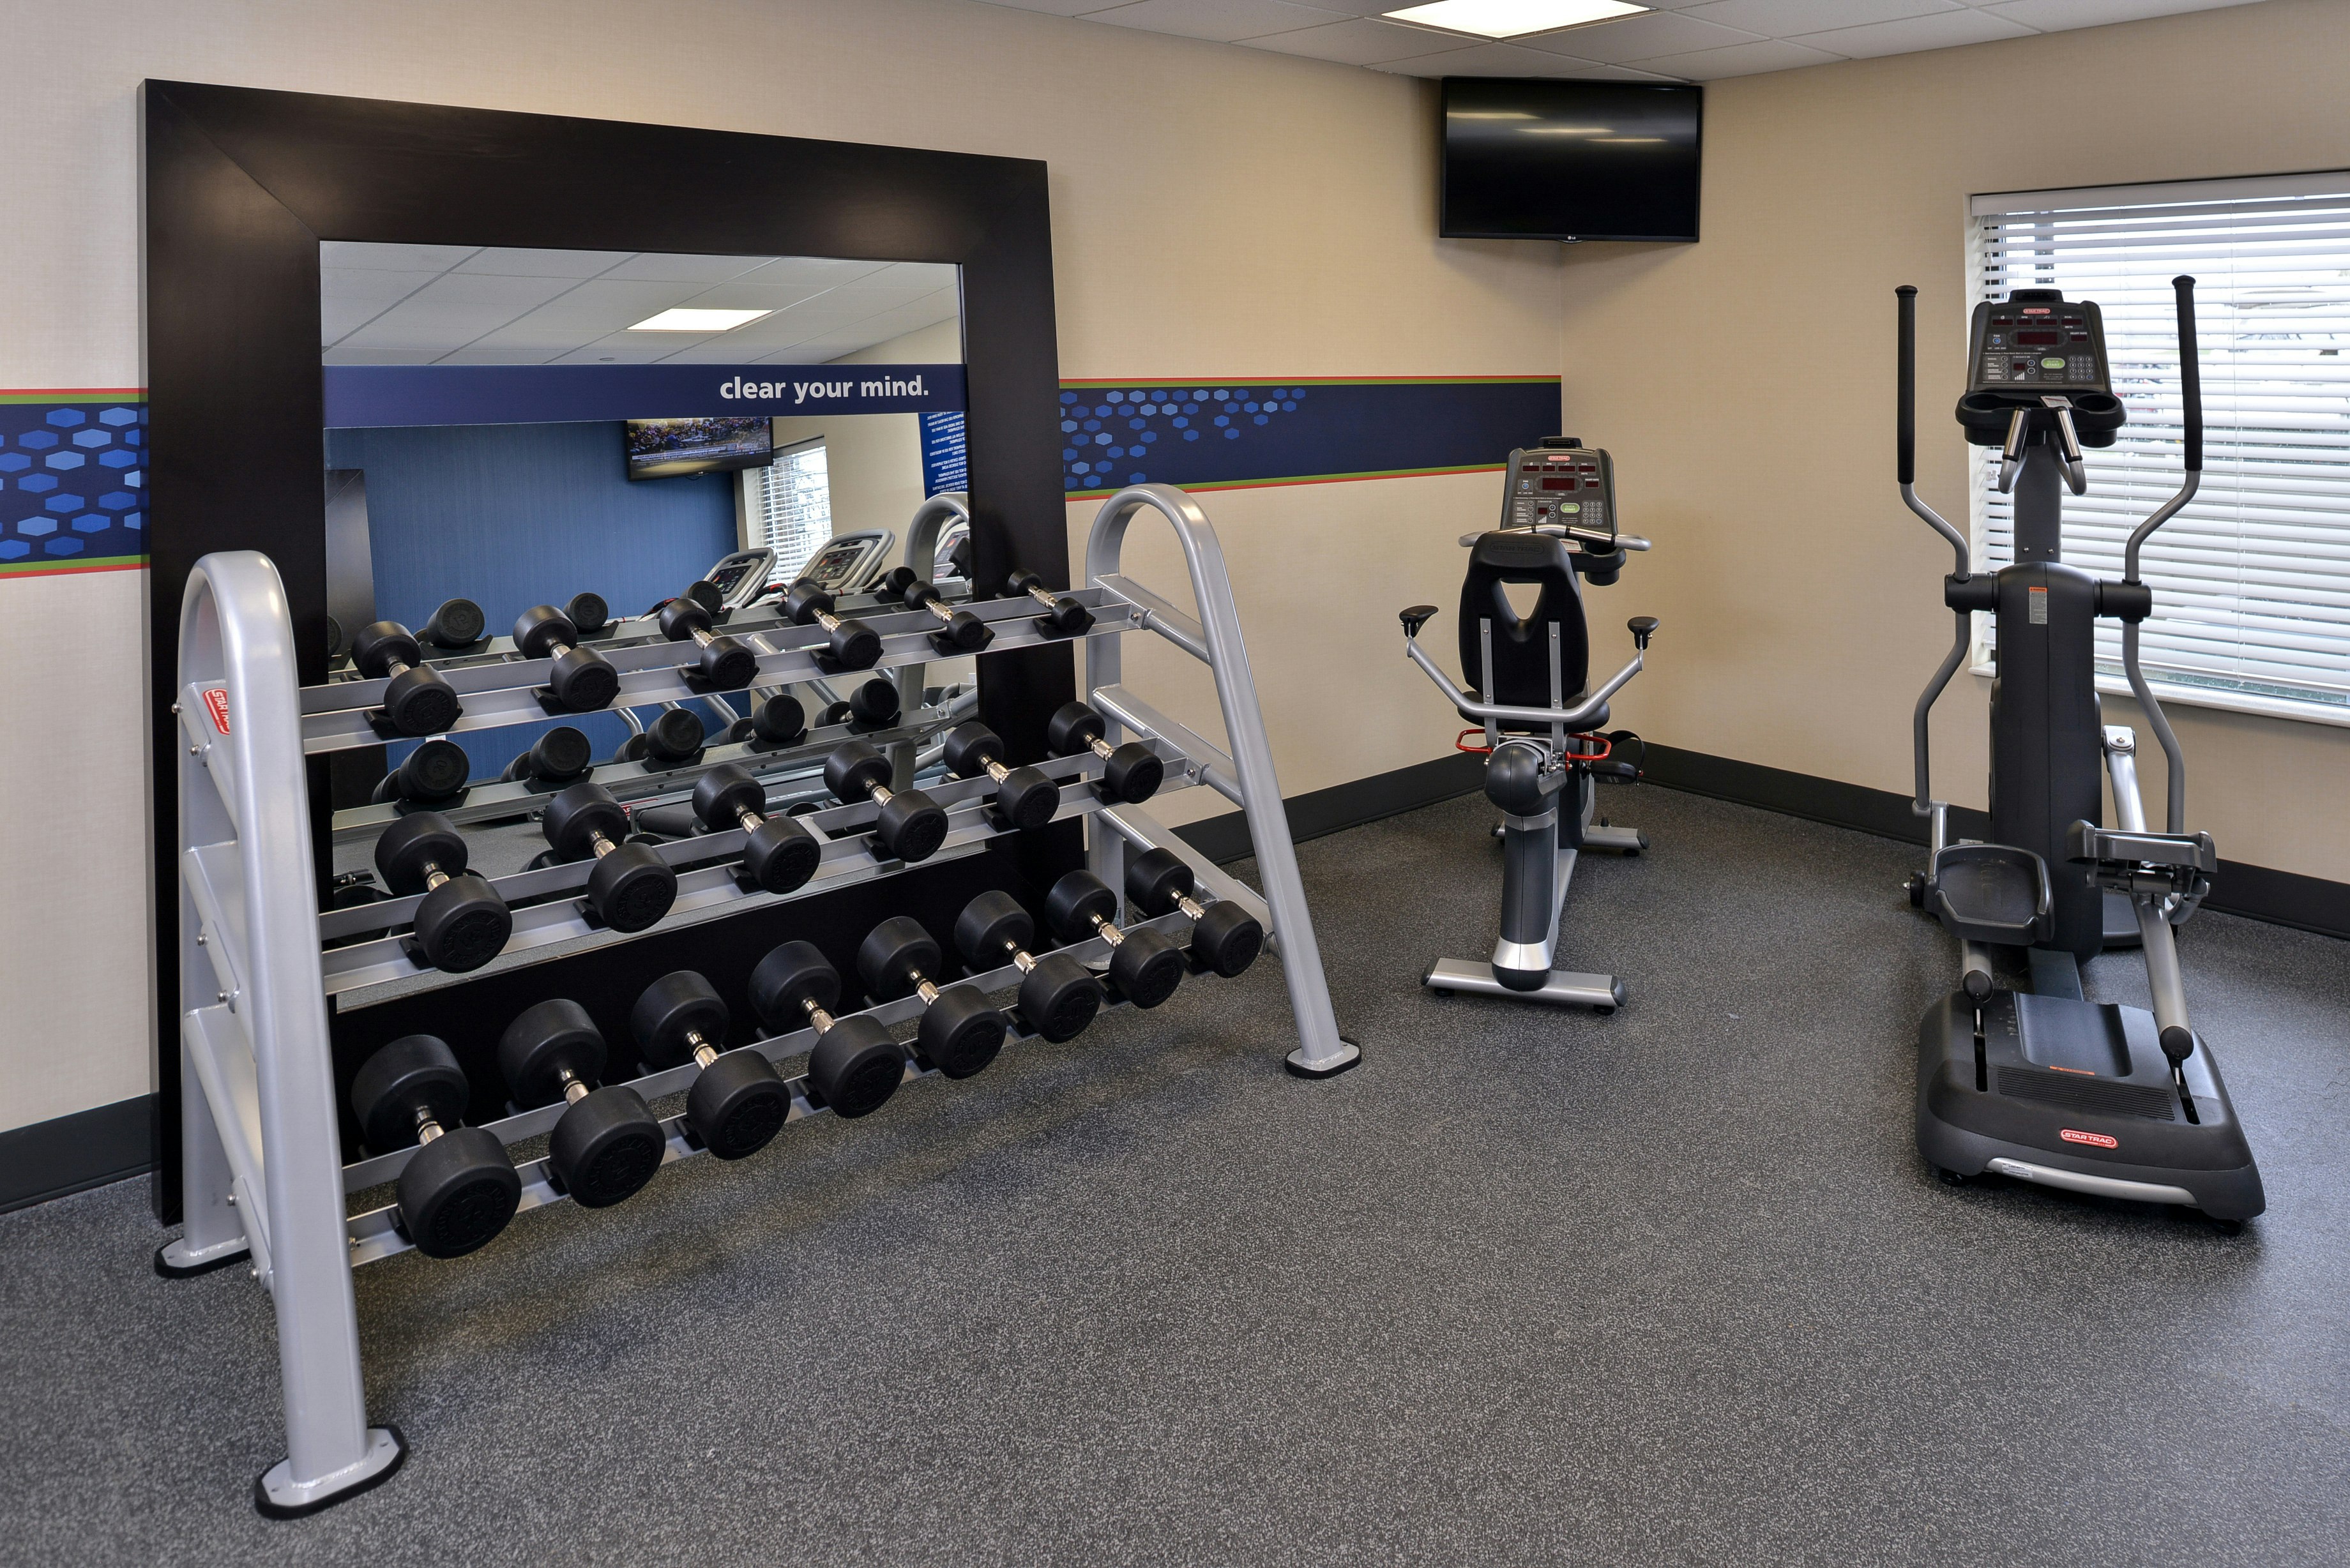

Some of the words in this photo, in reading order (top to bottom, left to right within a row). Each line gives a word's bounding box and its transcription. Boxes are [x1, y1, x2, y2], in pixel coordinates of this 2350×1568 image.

[720, 377, 786, 399] clear
[794, 382, 853, 404] your
[861, 375, 929, 397] mind.
[212, 691, 228, 710] STAR
[2088, 1136, 2112, 1144] TRAC
